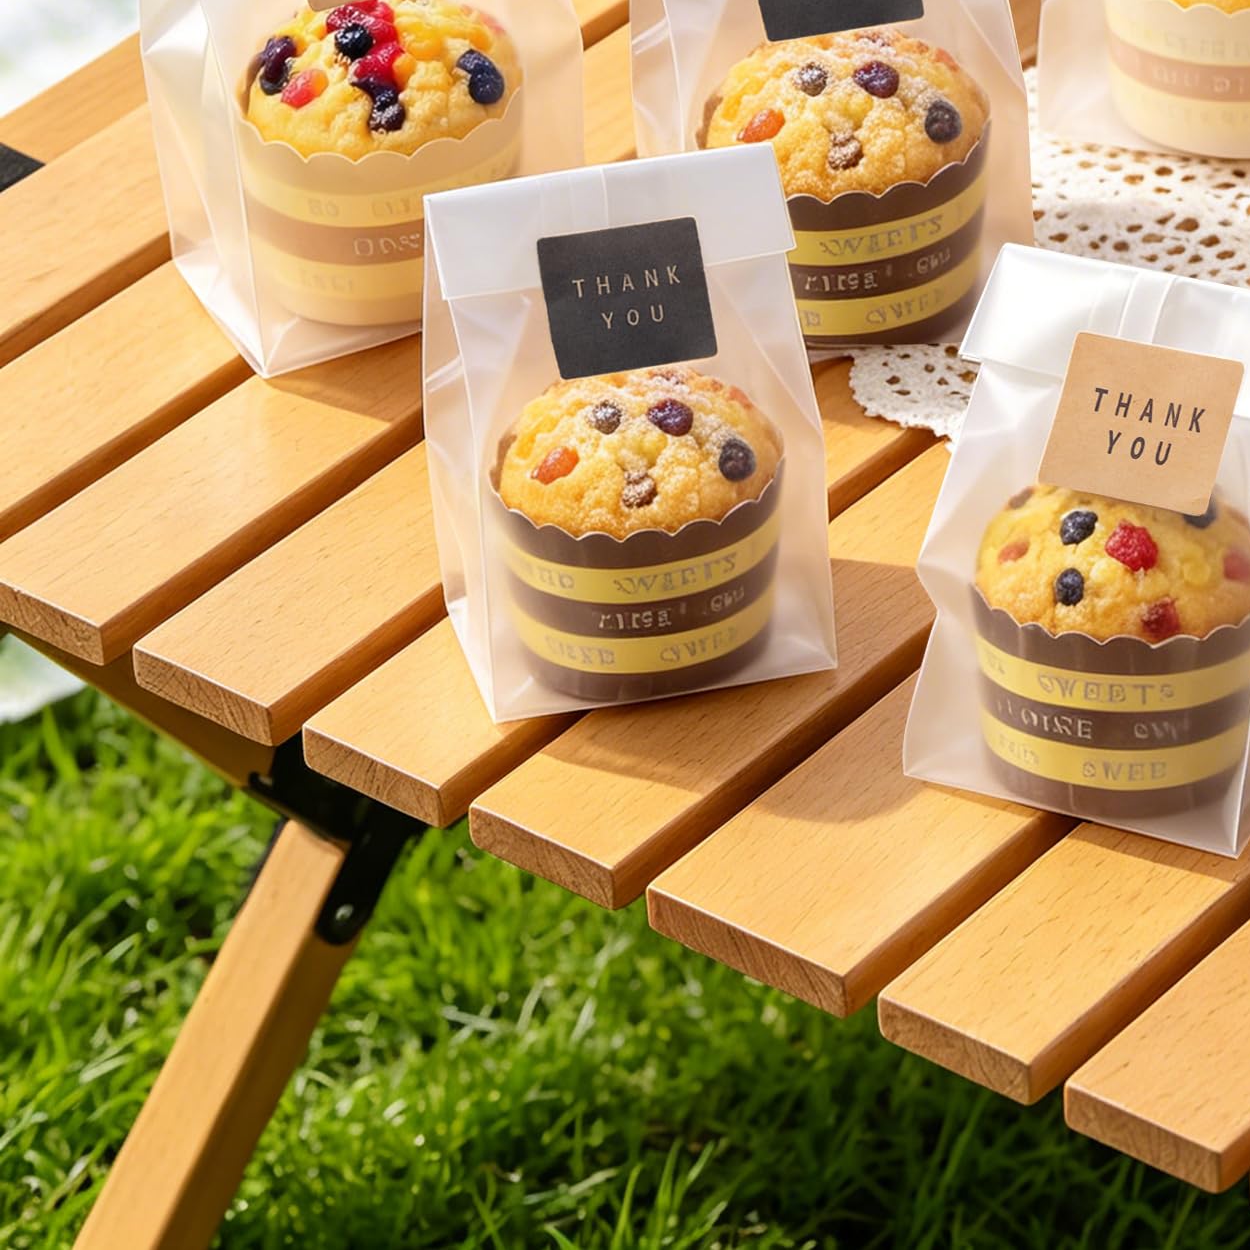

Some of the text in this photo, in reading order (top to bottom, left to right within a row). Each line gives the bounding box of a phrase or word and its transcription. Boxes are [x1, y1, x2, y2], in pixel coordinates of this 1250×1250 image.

[571, 264, 681, 298] THANK
[601, 304, 664, 330] YOU
[1094, 387, 1206, 434] THANK
[1107, 429, 1172, 466] YOU
